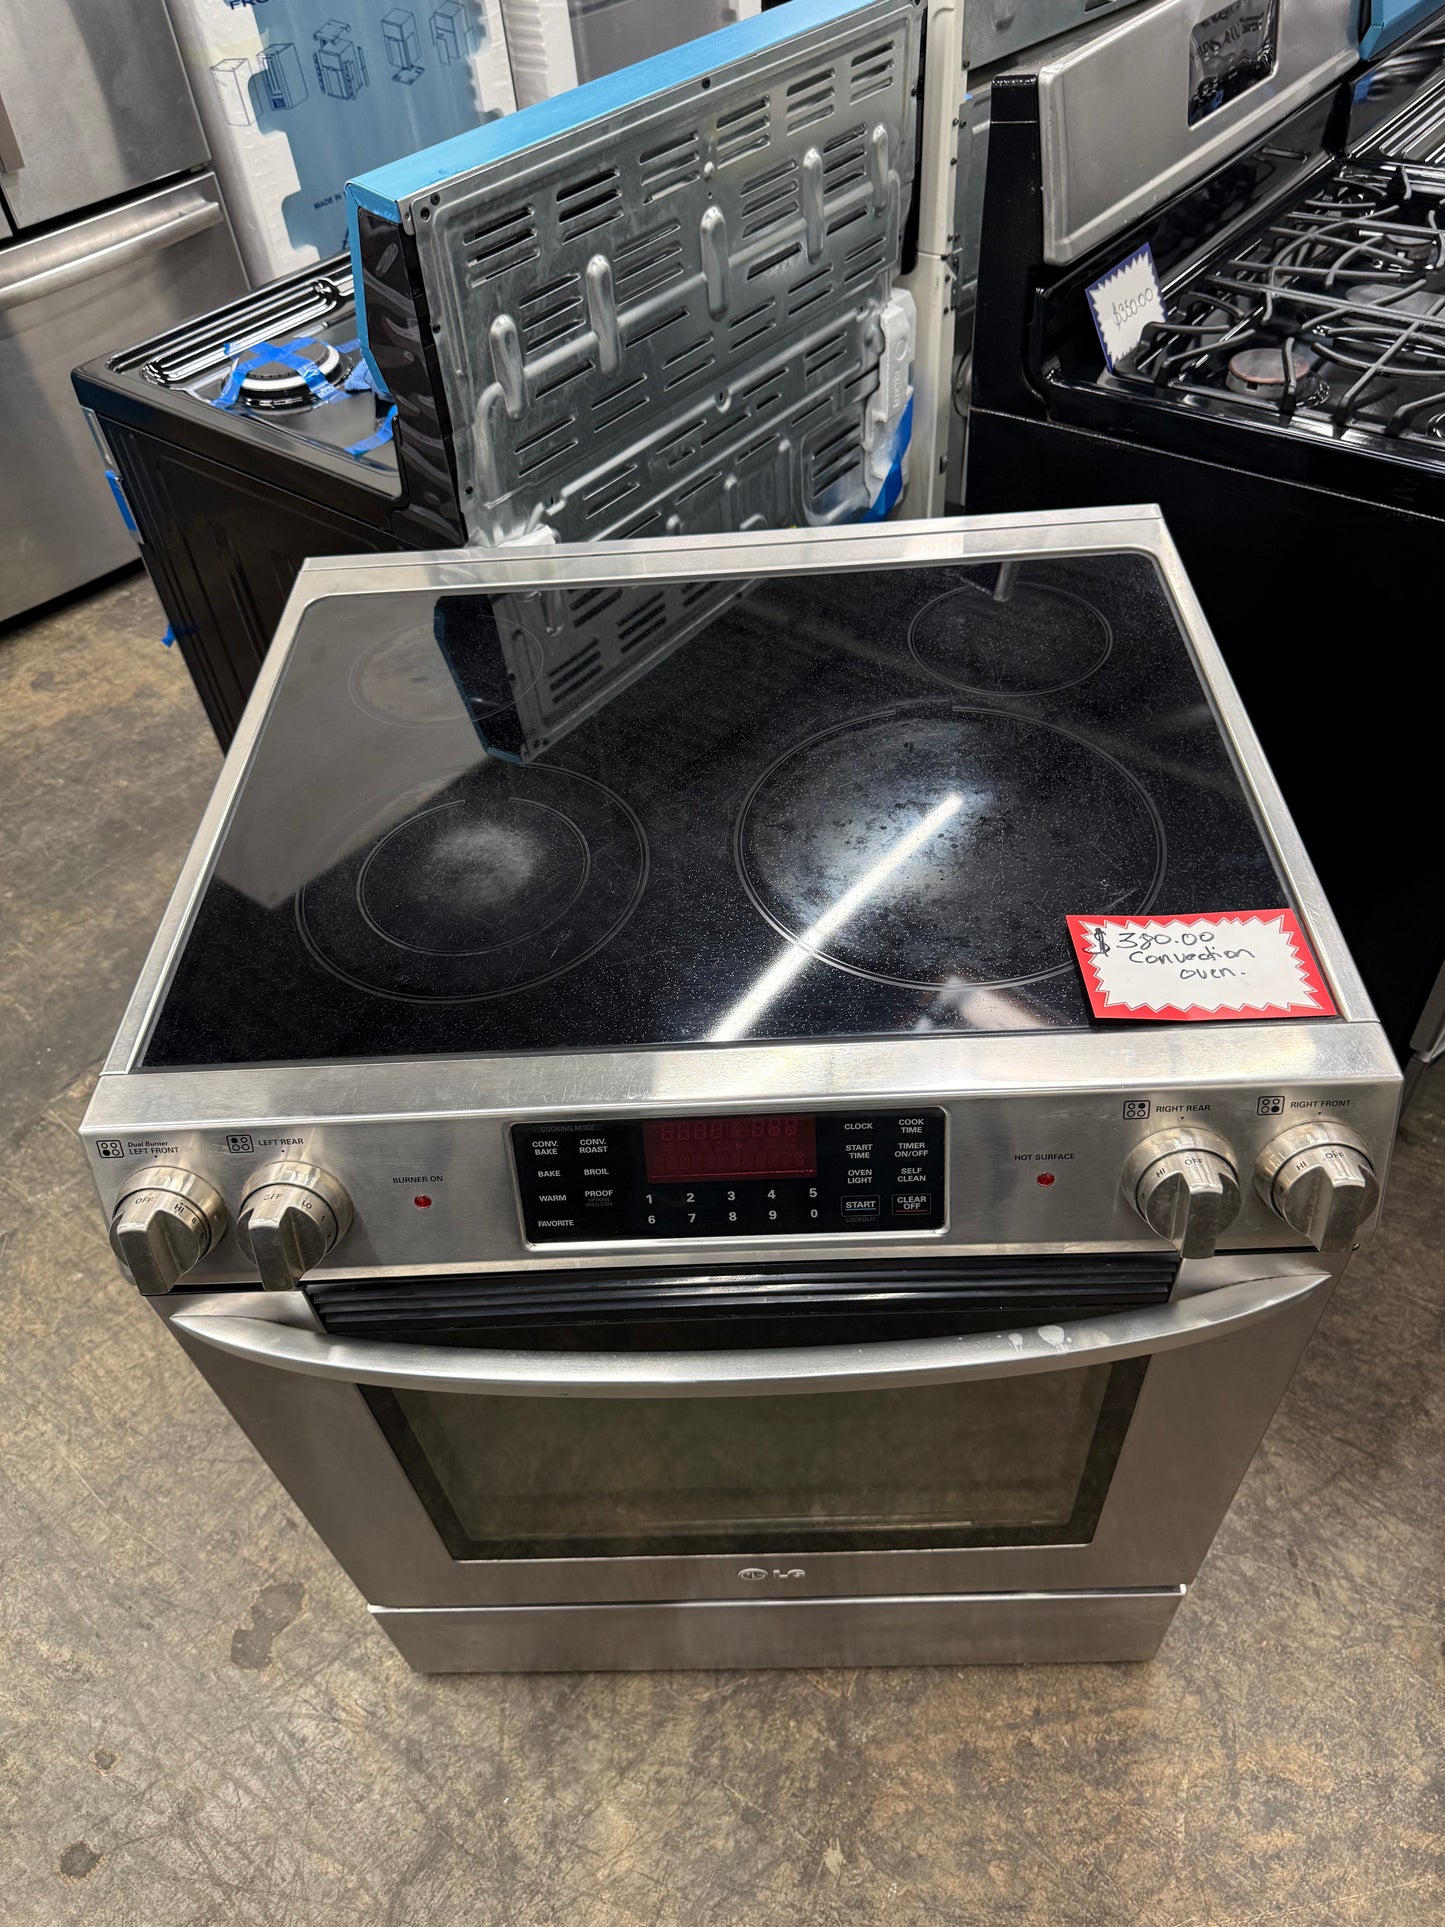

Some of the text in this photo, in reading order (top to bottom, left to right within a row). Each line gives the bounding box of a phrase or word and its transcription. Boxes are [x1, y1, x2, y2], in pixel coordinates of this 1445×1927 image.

[1128, 947, 1255, 965] Convection
[532, 1140, 559, 1148] CONV.
[1325, 1151, 1344, 1159] OFF
[1296, 1161, 1307, 1171] HI
[1156, 1168, 1166, 1178] HI
[392, 1176, 428, 1184] BURNER
[646, 1188, 818, 1204] 1 2 3 4 5
[302, 1200, 312, 1209] LO
[648, 1209, 818, 1224] 6 7 8 9 0
[773, 1569, 806, 1579] LG
